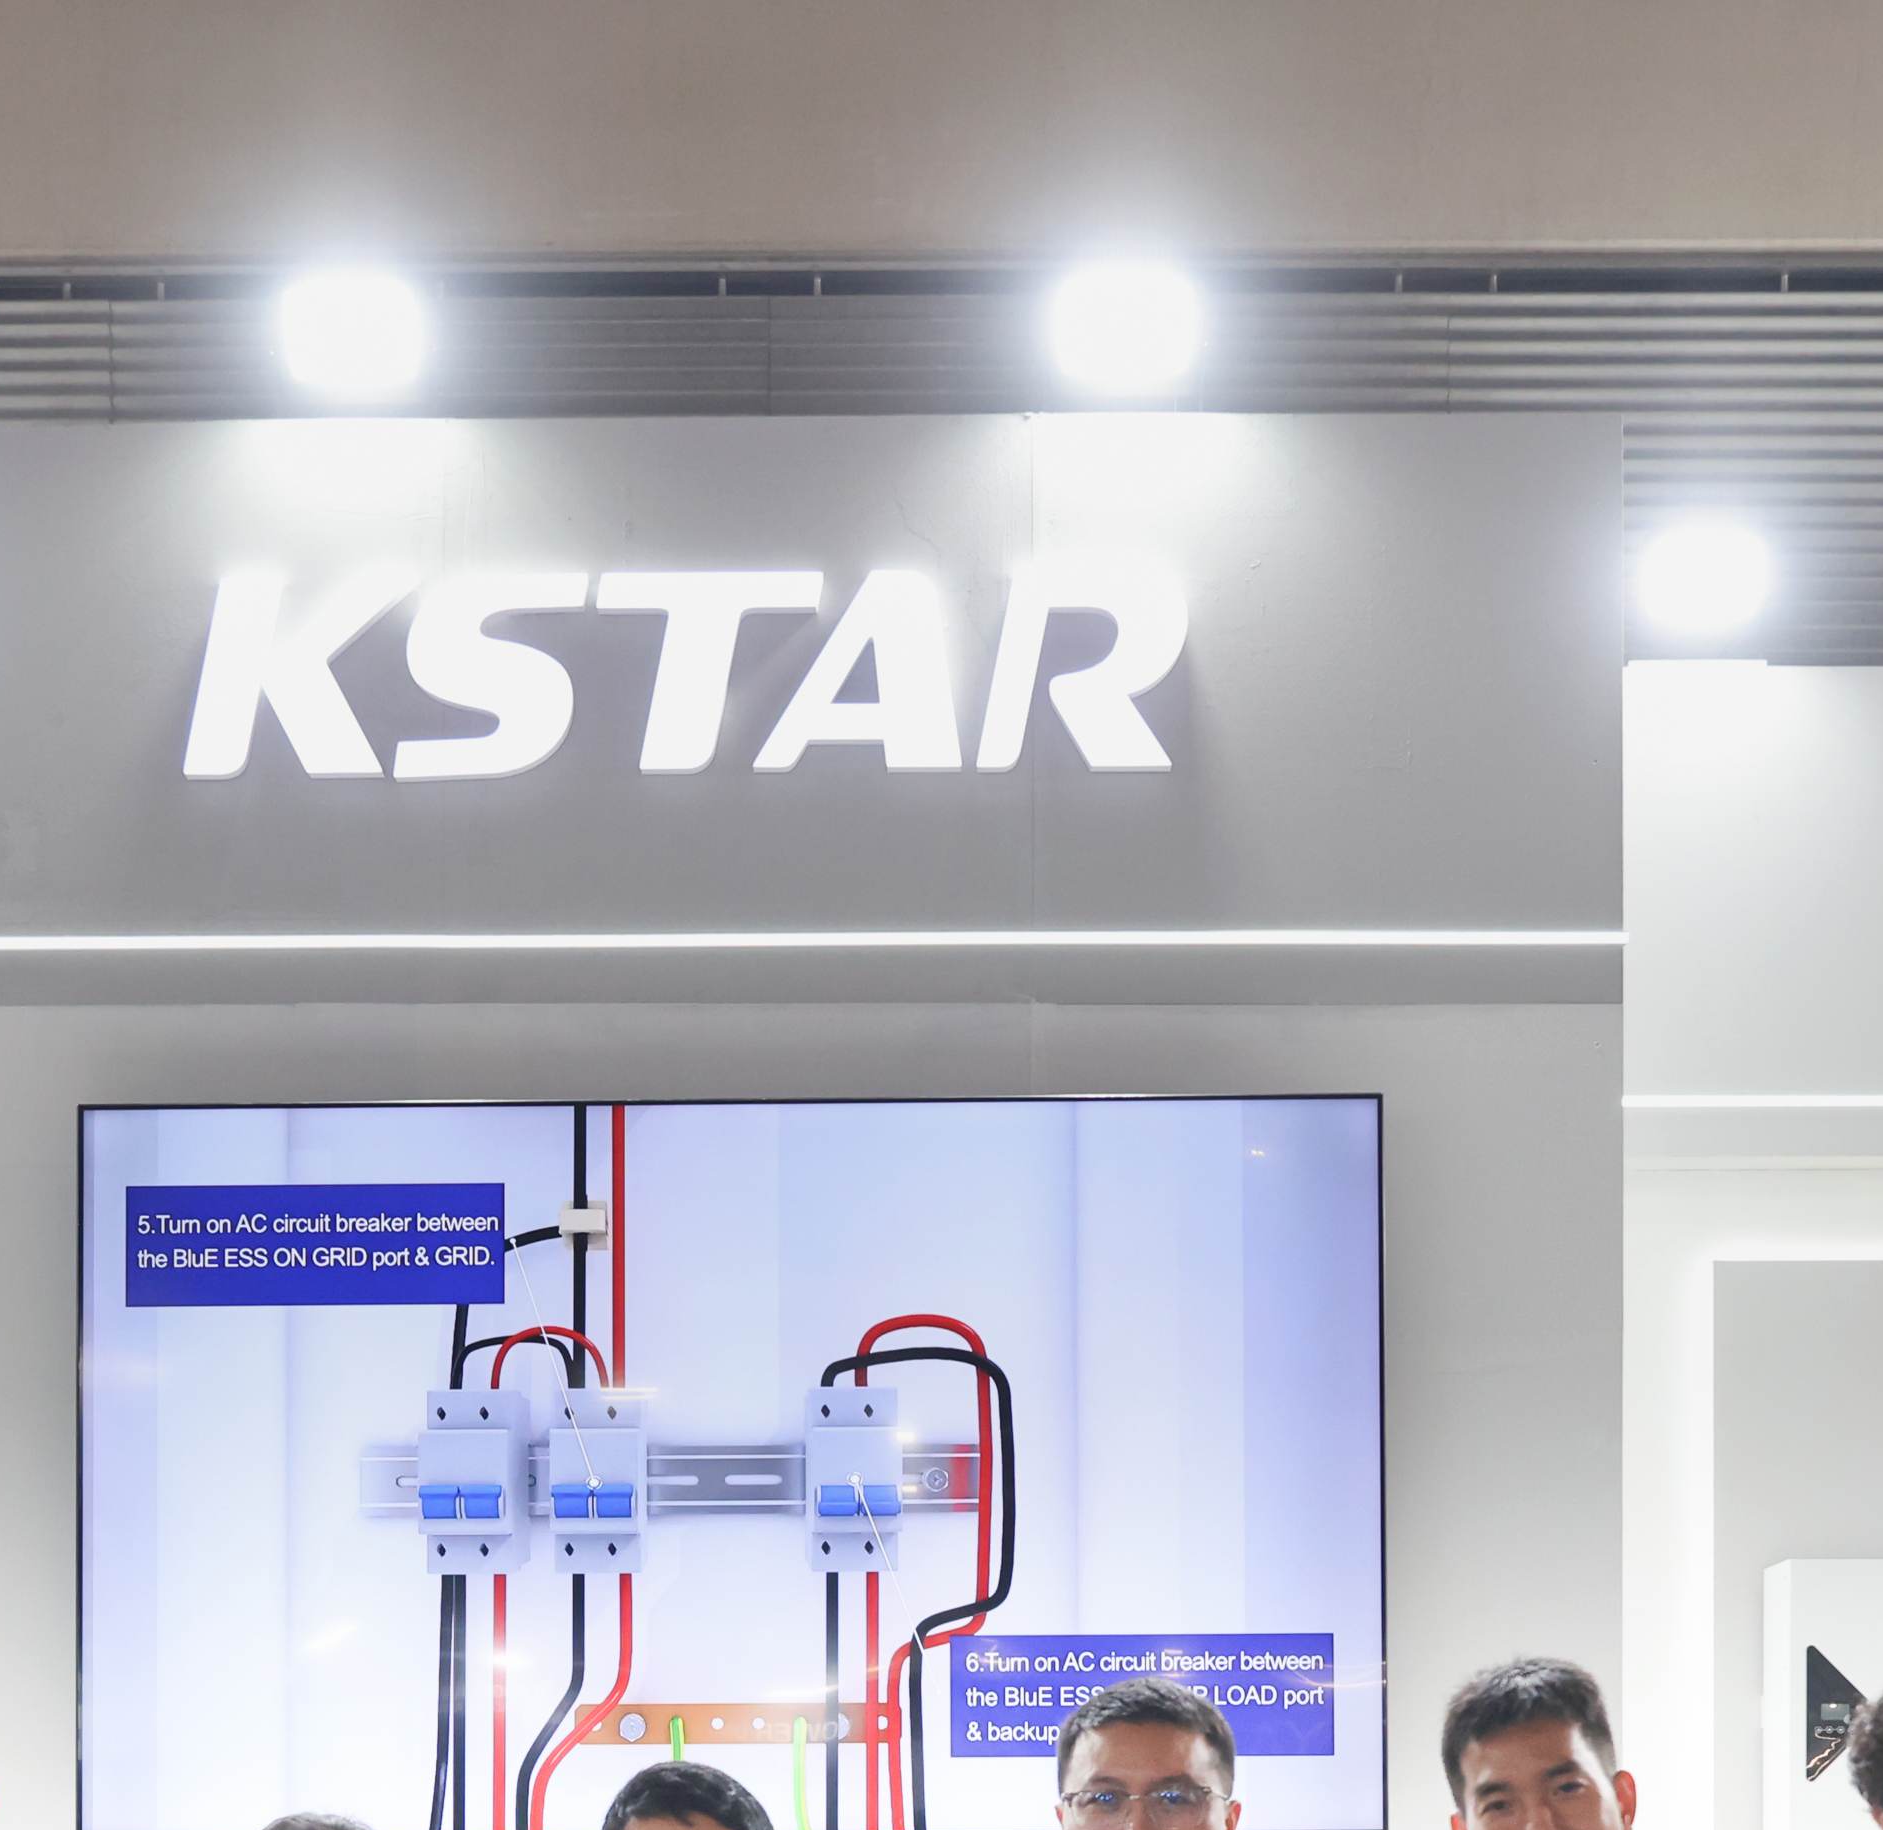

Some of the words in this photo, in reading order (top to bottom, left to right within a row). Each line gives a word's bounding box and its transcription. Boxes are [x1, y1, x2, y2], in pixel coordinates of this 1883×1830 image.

[183, 568, 1189, 782] KSTAR
[137, 1214, 202, 1235] 5.Turn
[206, 1218, 232, 1234] on
[236, 1214, 268, 1234] AC
[272, 1213, 332, 1233] circuit
[335, 1213, 412, 1233] breaker
[416, 1212, 500, 1232] between
[137, 1249, 169, 1268] the
[173, 1248, 219, 1268] BluE
[224, 1247, 269, 1267] ESS
[273, 1247, 307, 1267] ON
[312, 1247, 368, 1267] GRID
[372, 1247, 410, 1271] port
[414, 1246, 430, 1267] &
[434, 1246, 495, 1266] GRID.
[966, 1653, 1030, 1674] 6.Turn
[1034, 1656, 1060, 1673] on
[1063, 1652, 1095, 1672] AC
[1099, 1652, 1157, 1672] circuit
[1160, 1652, 1237, 1672] breaker
[1240, 1651, 1324, 1671] between
[966, 1687, 998, 1706] the
[1004, 1686, 1054, 1706] BluE
[1214, 1685, 1278, 1705] LOAD
[1283, 1686, 1325, 1708] port
[966, 1722, 982, 1742] &
[988, 1722, 1060, 1744] backup
